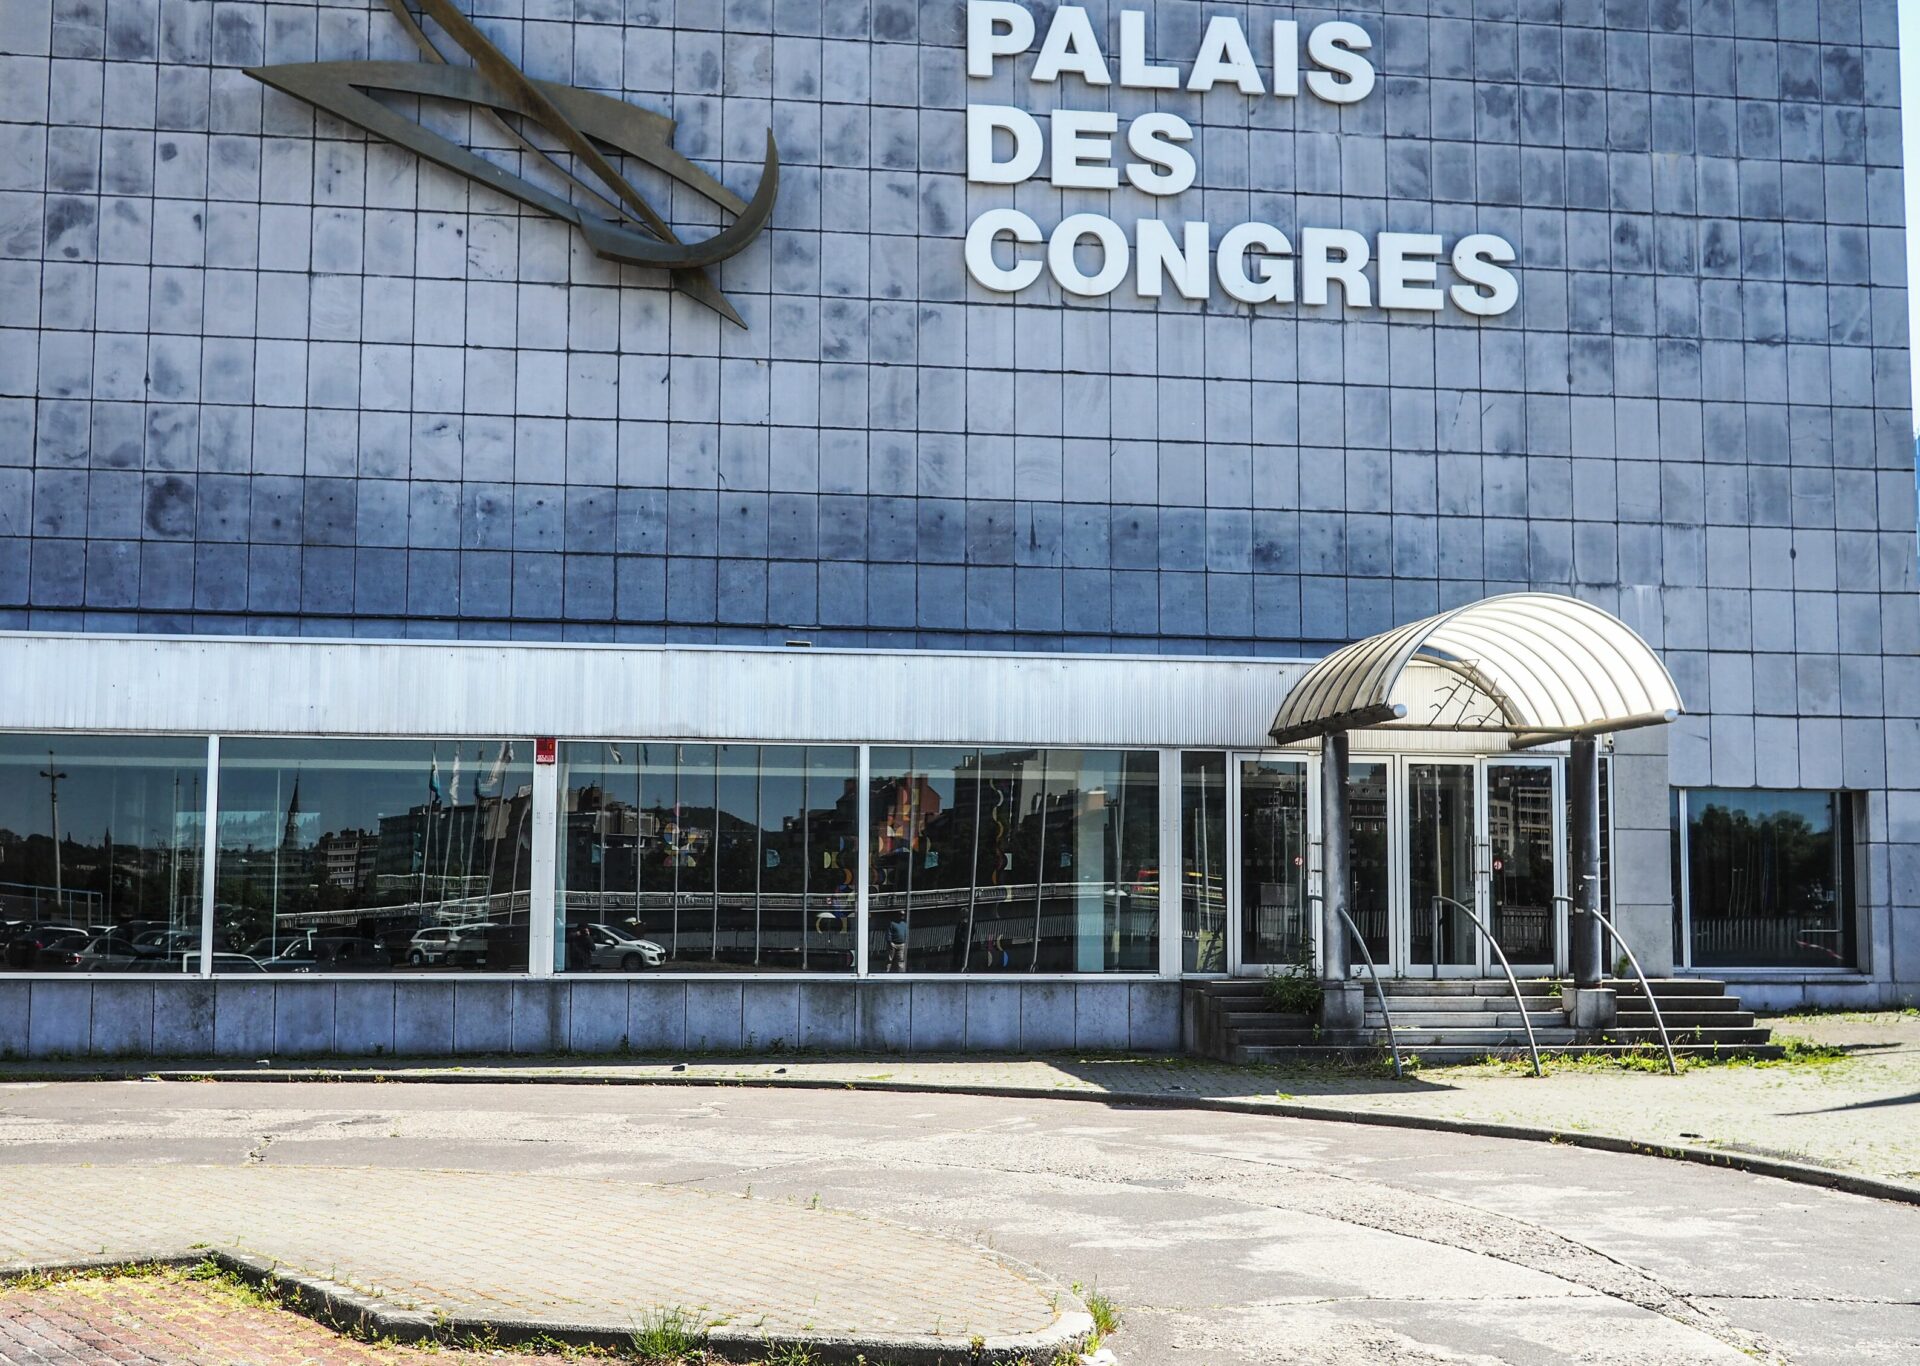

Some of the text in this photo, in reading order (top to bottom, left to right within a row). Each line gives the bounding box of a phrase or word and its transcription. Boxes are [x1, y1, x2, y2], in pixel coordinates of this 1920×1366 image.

[967, 0, 1376, 103] PALAIS
[967, 104, 1197, 196] DES
[965, 208, 1519, 316] CONGRES
